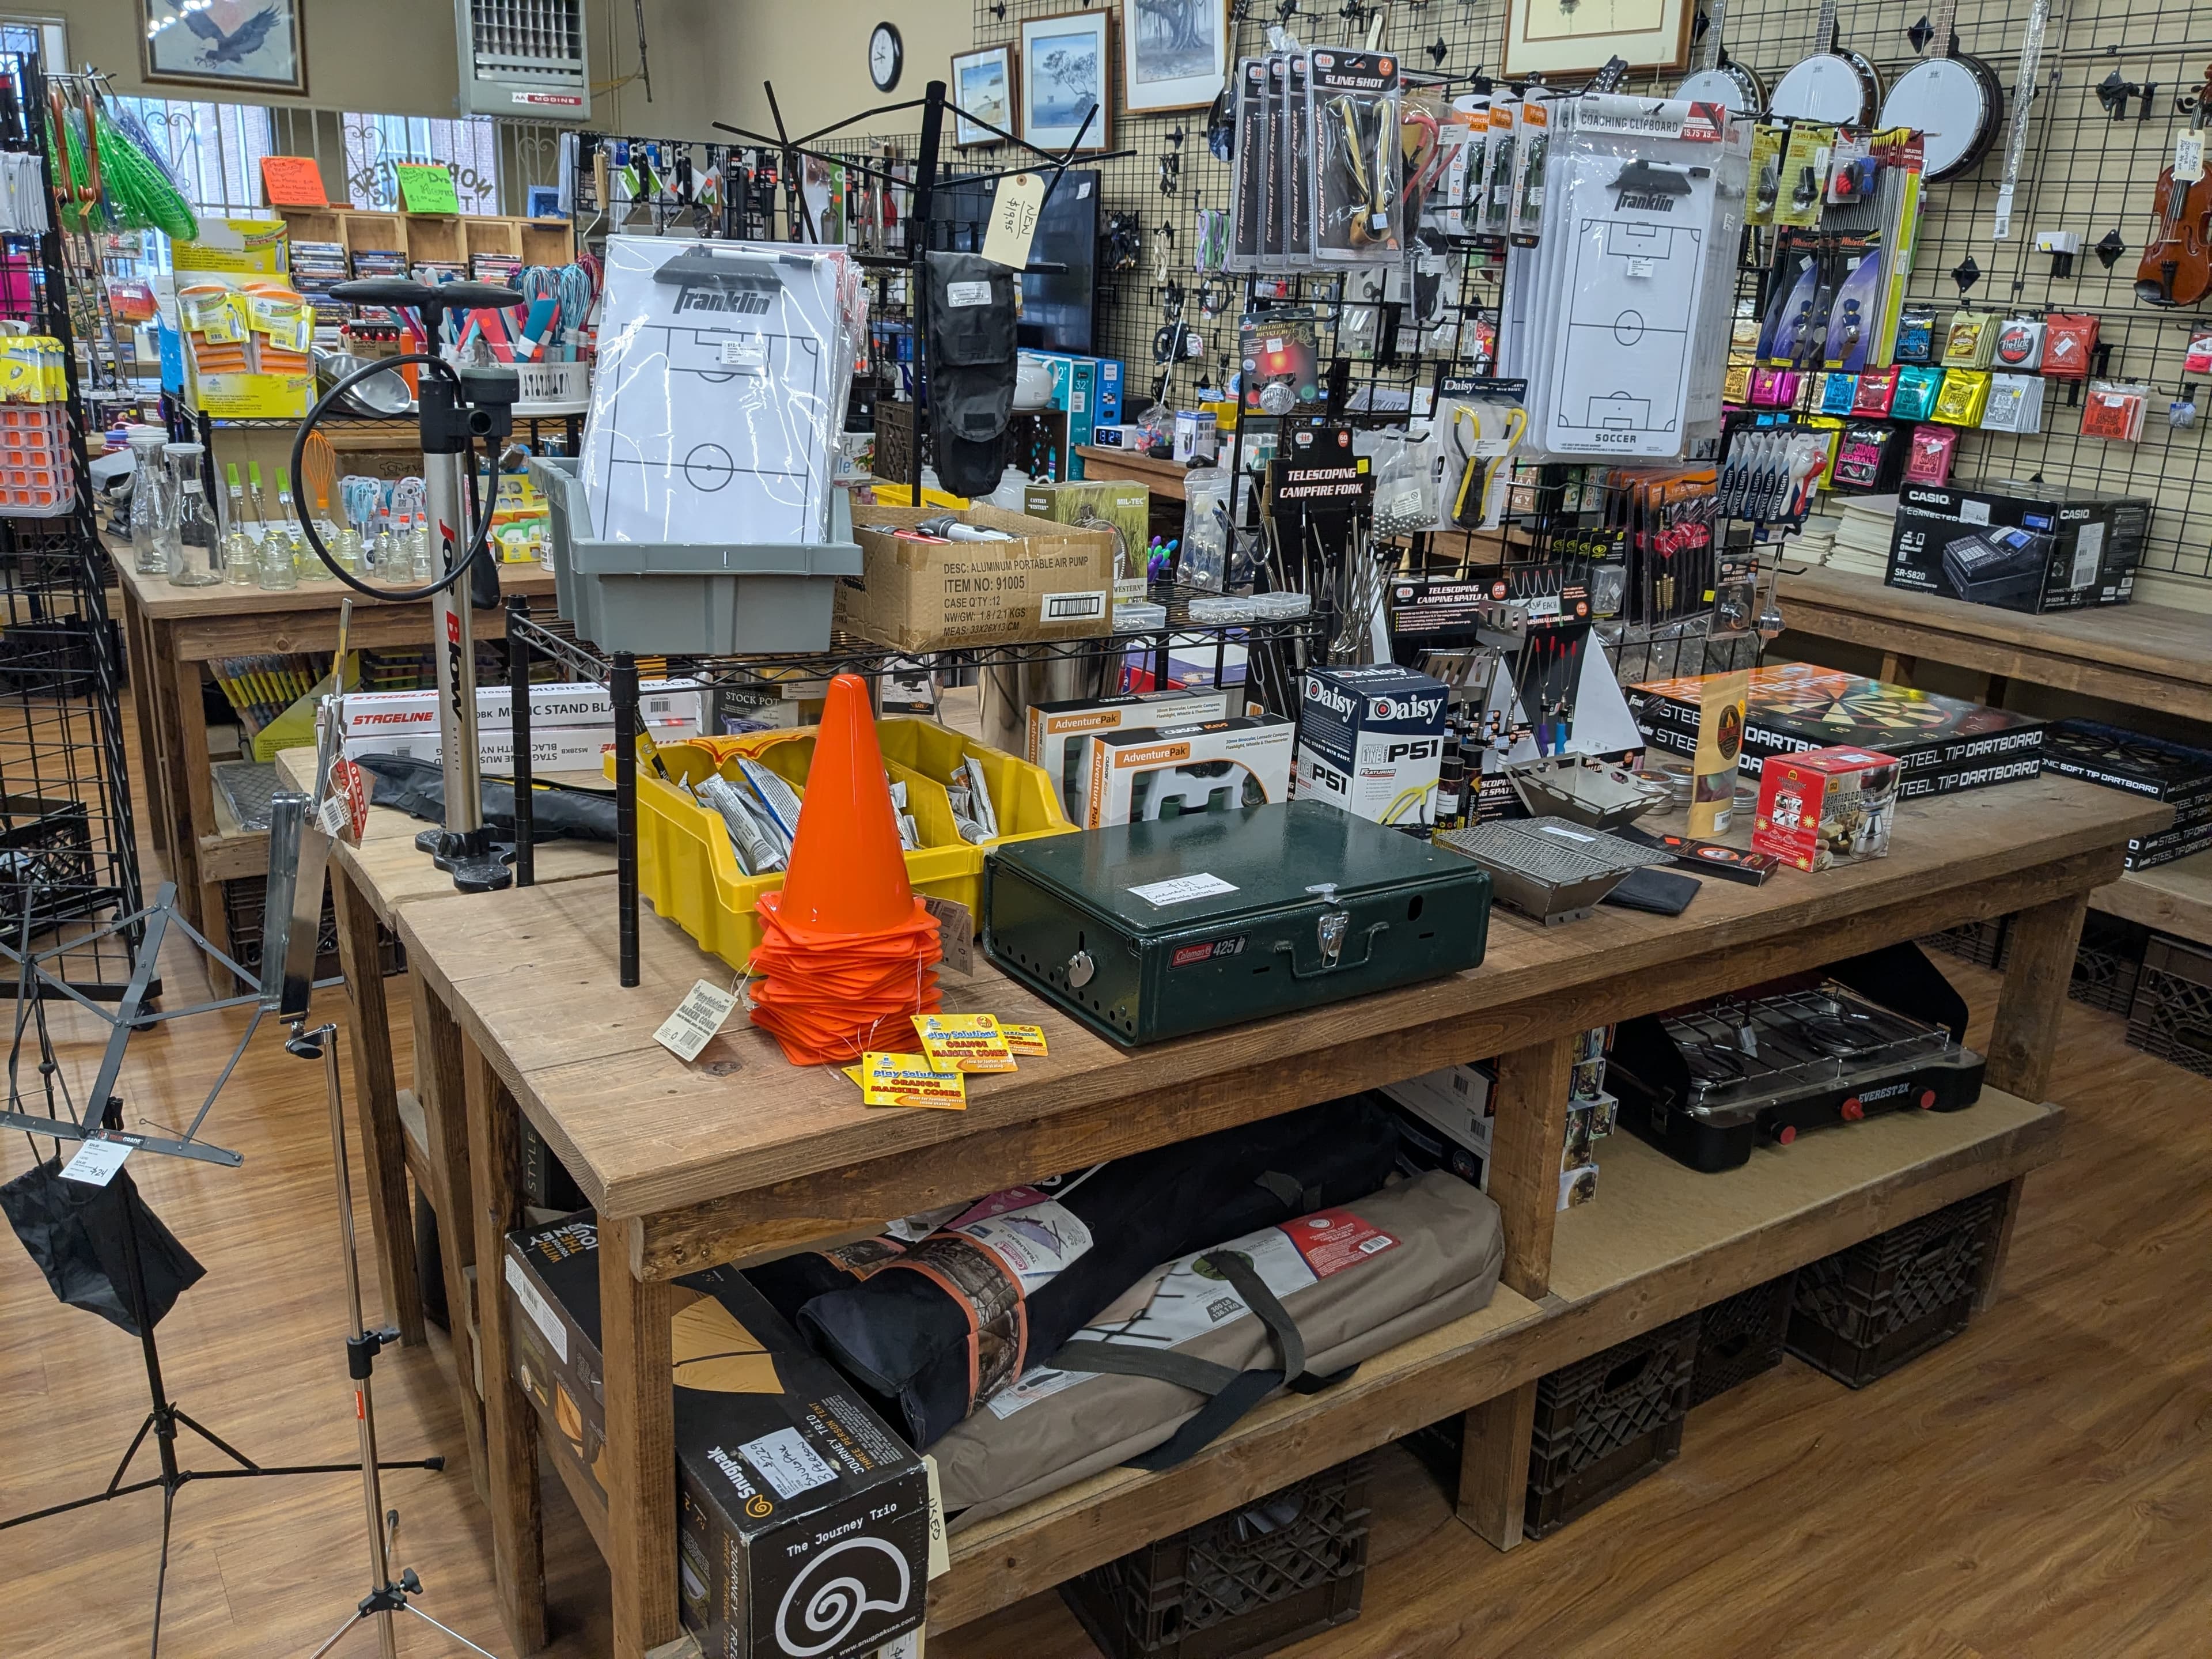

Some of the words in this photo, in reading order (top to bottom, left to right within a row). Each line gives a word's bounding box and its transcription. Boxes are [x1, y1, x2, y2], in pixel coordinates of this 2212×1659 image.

[1325, 75, 1355, 85] SLING
[1357, 78, 1384, 88] SHOT
[534, 96, 575, 104] MODINE
[1316, 104, 1324, 145] Practice
[1581, 114, 1627, 128] COACHING
[1630, 119, 1677, 132] CLIPBOARD
[1319, 177, 1323, 189] of
[1241, 185, 1246, 199] of
[1003, 198, 1020, 233] $19.95
[1021, 204, 1037, 235] NEW
[1444, 380, 1475, 393] Daisy
[1595, 434, 1636, 443] SOCCER
[1287, 468, 1357, 482] TELESCOPING
[1279, 486, 1335, 498] CAMPFIRE
[1335, 483, 1363, 494] FORK
[1909, 490, 1950, 505] CASIO
[1117, 498, 1145, 506] MIL-TEC
[1718, 490, 1728, 514] BICYCLE
[1732, 490, 1742, 516] BICYCLE
[1746, 491, 1756, 517] BICYCLE
[1758, 494, 1768, 519] BICYCLE
[1770, 494, 1782, 521] BICYCLE
[1907, 509, 1957, 521] CONNECTED
[2060, 509, 2089, 520] CASIO
[944, 563, 969, 574] DESC:
[971, 560, 1012, 573] ALUMINUM
[1014, 558, 1054, 570] PORTABLE
[1055, 558, 1067, 567] AIR
[1069, 556, 1088, 566] PUMP
[1894, 568, 1925, 580] SR-S820
[944, 578, 971, 593] ITEM
[974, 577, 993, 592] NO:
[997, 576, 1025, 590] 91005
[1429, 585, 1479, 594] TELESCOPING
[944, 597, 967, 608] CASE
[969, 596, 987, 607] Q'TY
[1417, 596, 1453, 604] CAMPING
[1454, 594, 1488, 603] SPATULA
[1543, 601, 1557, 610] EACH
[944, 612, 976, 623] NW/GW:
[980, 611, 991, 620] 1.8
[997, 609, 1007, 619] 2.1
[1009, 608, 1025, 618] KGS
[944, 626, 968, 637] MEAS:
[970, 623, 1006, 635] 33X26X13
[1007, 622, 1019, 631] CM
[726, 691, 756, 704] STOCK
[759, 696, 779, 706] POT
[1304, 675, 1357, 723] Daisy
[544, 703, 589, 715] STAND
[1365, 694, 1443, 725] Daisy
[353, 712, 435, 725] STAGELINE
[1164, 726, 1203, 735] CARSON
[1312, 740, 1325, 751] STARTS
[1326, 747, 1337, 756] WITH
[1363, 745, 1382, 753] POWER
[1388, 739, 1438, 763] P51
[1945, 745, 1964, 760] TIP
[1967, 731, 2043, 757] DARTBOARD
[1362, 752, 1382, 764] LINE
[1312, 763, 1348, 796] P51
[1941, 775, 1958, 790] TIP
[1960, 760, 2039, 786] DARTBOARD
[2060, 763, 2084, 775] SOFT
[2086, 769, 2100, 778] TIP
[2101, 774, 2158, 794] DARTBOARD
[1826, 792, 1854, 805] PORTABLE
[1855, 788, 1876, 800] BUTANE
[1825, 805, 1846, 816] BURNER
[1846, 804, 1859, 813] SET
[1177, 950, 1205, 961] Coleman
[1213, 940, 1235, 956] 425
[976, 1049, 1008, 1057] CONES
[870, 1086, 920, 1094] MARKER
[923, 1089, 961, 1097] CONES
[1858, 1085, 1897, 1103] EVEREST
[1897, 1082, 1910, 1094] 2X
[1211, 1303, 1222, 1312] 300
[1213, 1308, 1229, 1319] 136.1
[808, 1403, 828, 1418] TENT
[806, 1415, 828, 1435] TRIO
[826, 1420, 853, 1446] PERSON
[827, 1439, 864, 1475] JOURNEY
[851, 1448, 874, 1470] THREE
[707, 1446, 756, 1499] Snugpak
[786, 1540, 809, 1558] The
[815, 1516, 864, 1546] Journey
[870, 1502, 897, 1521] Trio
[838, 1615, 916, 1657] www.snugpakusa.com
